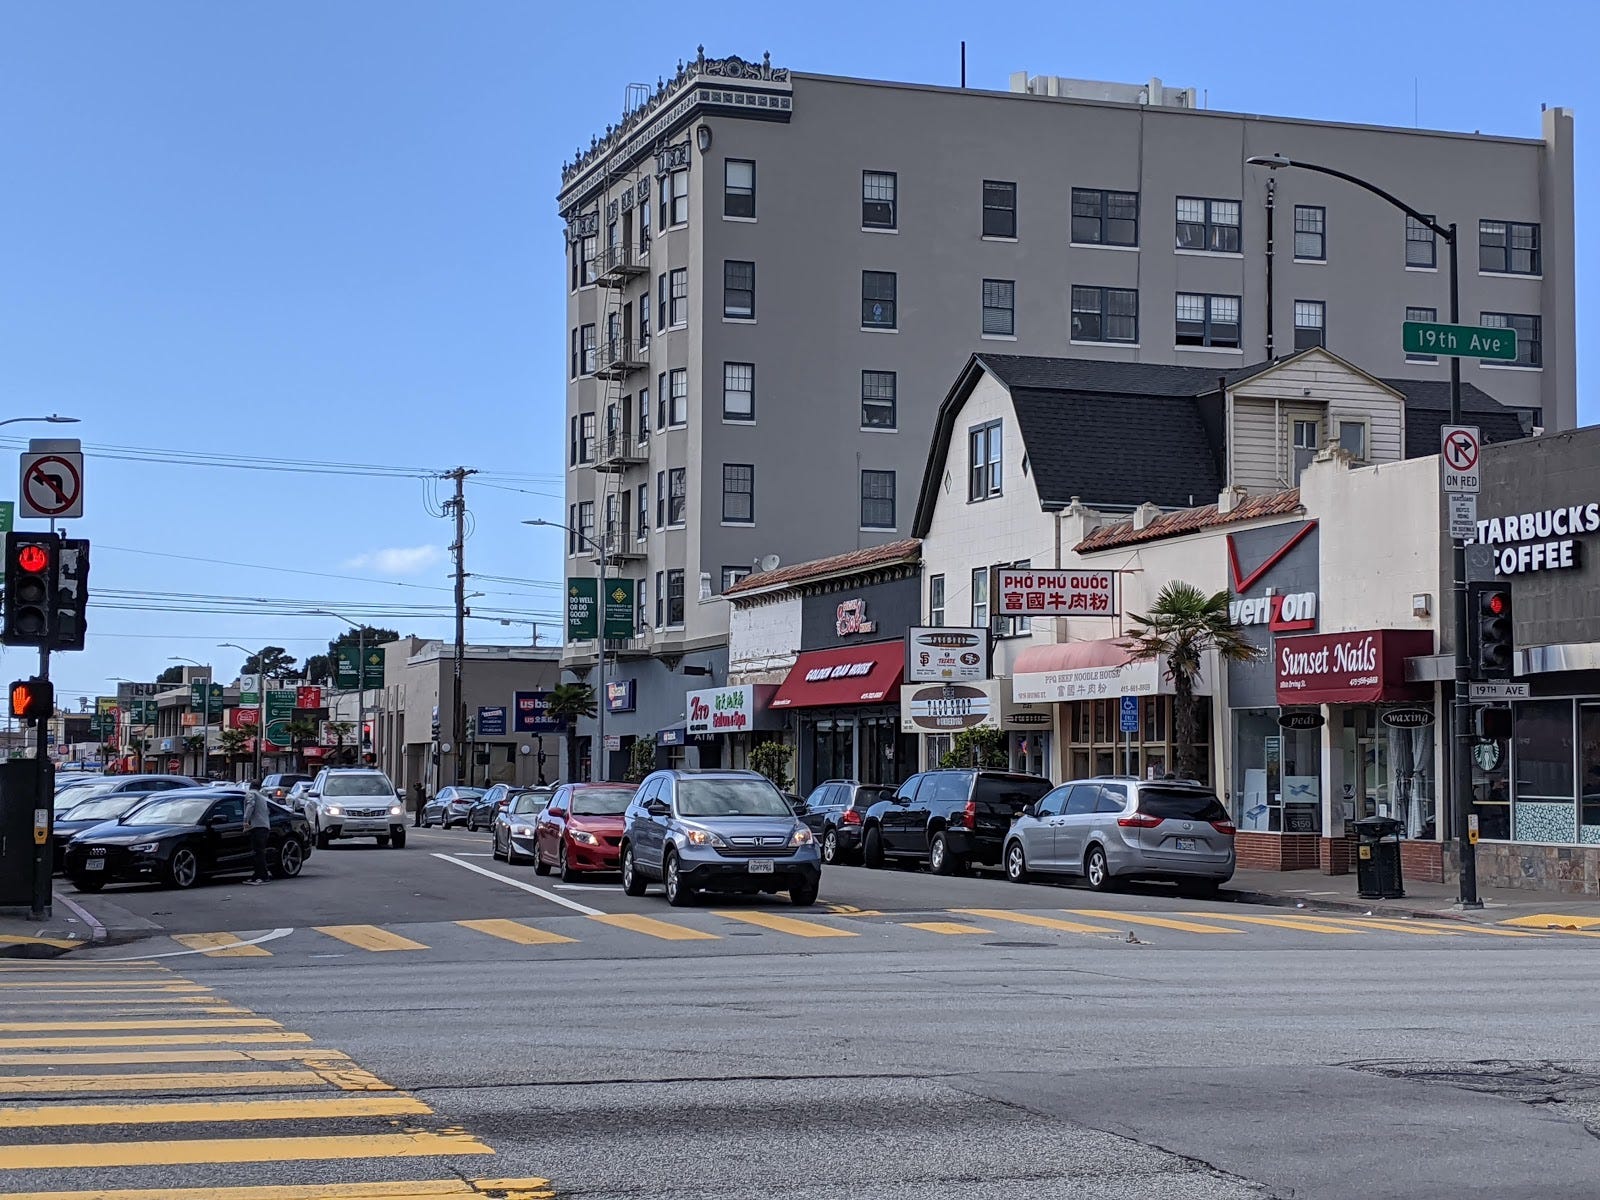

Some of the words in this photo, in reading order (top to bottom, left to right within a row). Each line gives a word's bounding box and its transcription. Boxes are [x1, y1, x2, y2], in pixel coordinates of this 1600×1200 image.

[1418, 329, 1457, 349] 19th
[1469, 333, 1501, 352] Ave
[1446, 475, 1458, 486] ON
[1460, 476, 1477, 487] RED
[1464, 503, 1600, 545] TARBUCKS
[1004, 571, 1034, 589] PHỞ
[1037, 573, 1067, 589] PHÚ
[1070, 572, 1109, 589] QUỐC
[569, 596, 578, 604] DO
[578, 596, 594, 604] WELL
[569, 603, 578, 611] OR
[578, 603, 587, 611] DO
[1004, 591, 1109, 611] 富國牛肉粉
[1229, 587, 1317, 633] verizon
[1280, 645, 1330, 677] Sunset
[1333, 636, 1377, 673] Nails
[1074, 671, 1100, 682] NOODLE
[1475, 686, 1497, 695] 19TH
[1505, 686, 1524, 695] AVE
[927, 699, 948, 717] TACO
[950, 698, 972, 716] SHOP
[712, 711, 730, 728] Salon
[1291, 714, 1315, 728] pedi
[1387, 713, 1429, 727] waxing
